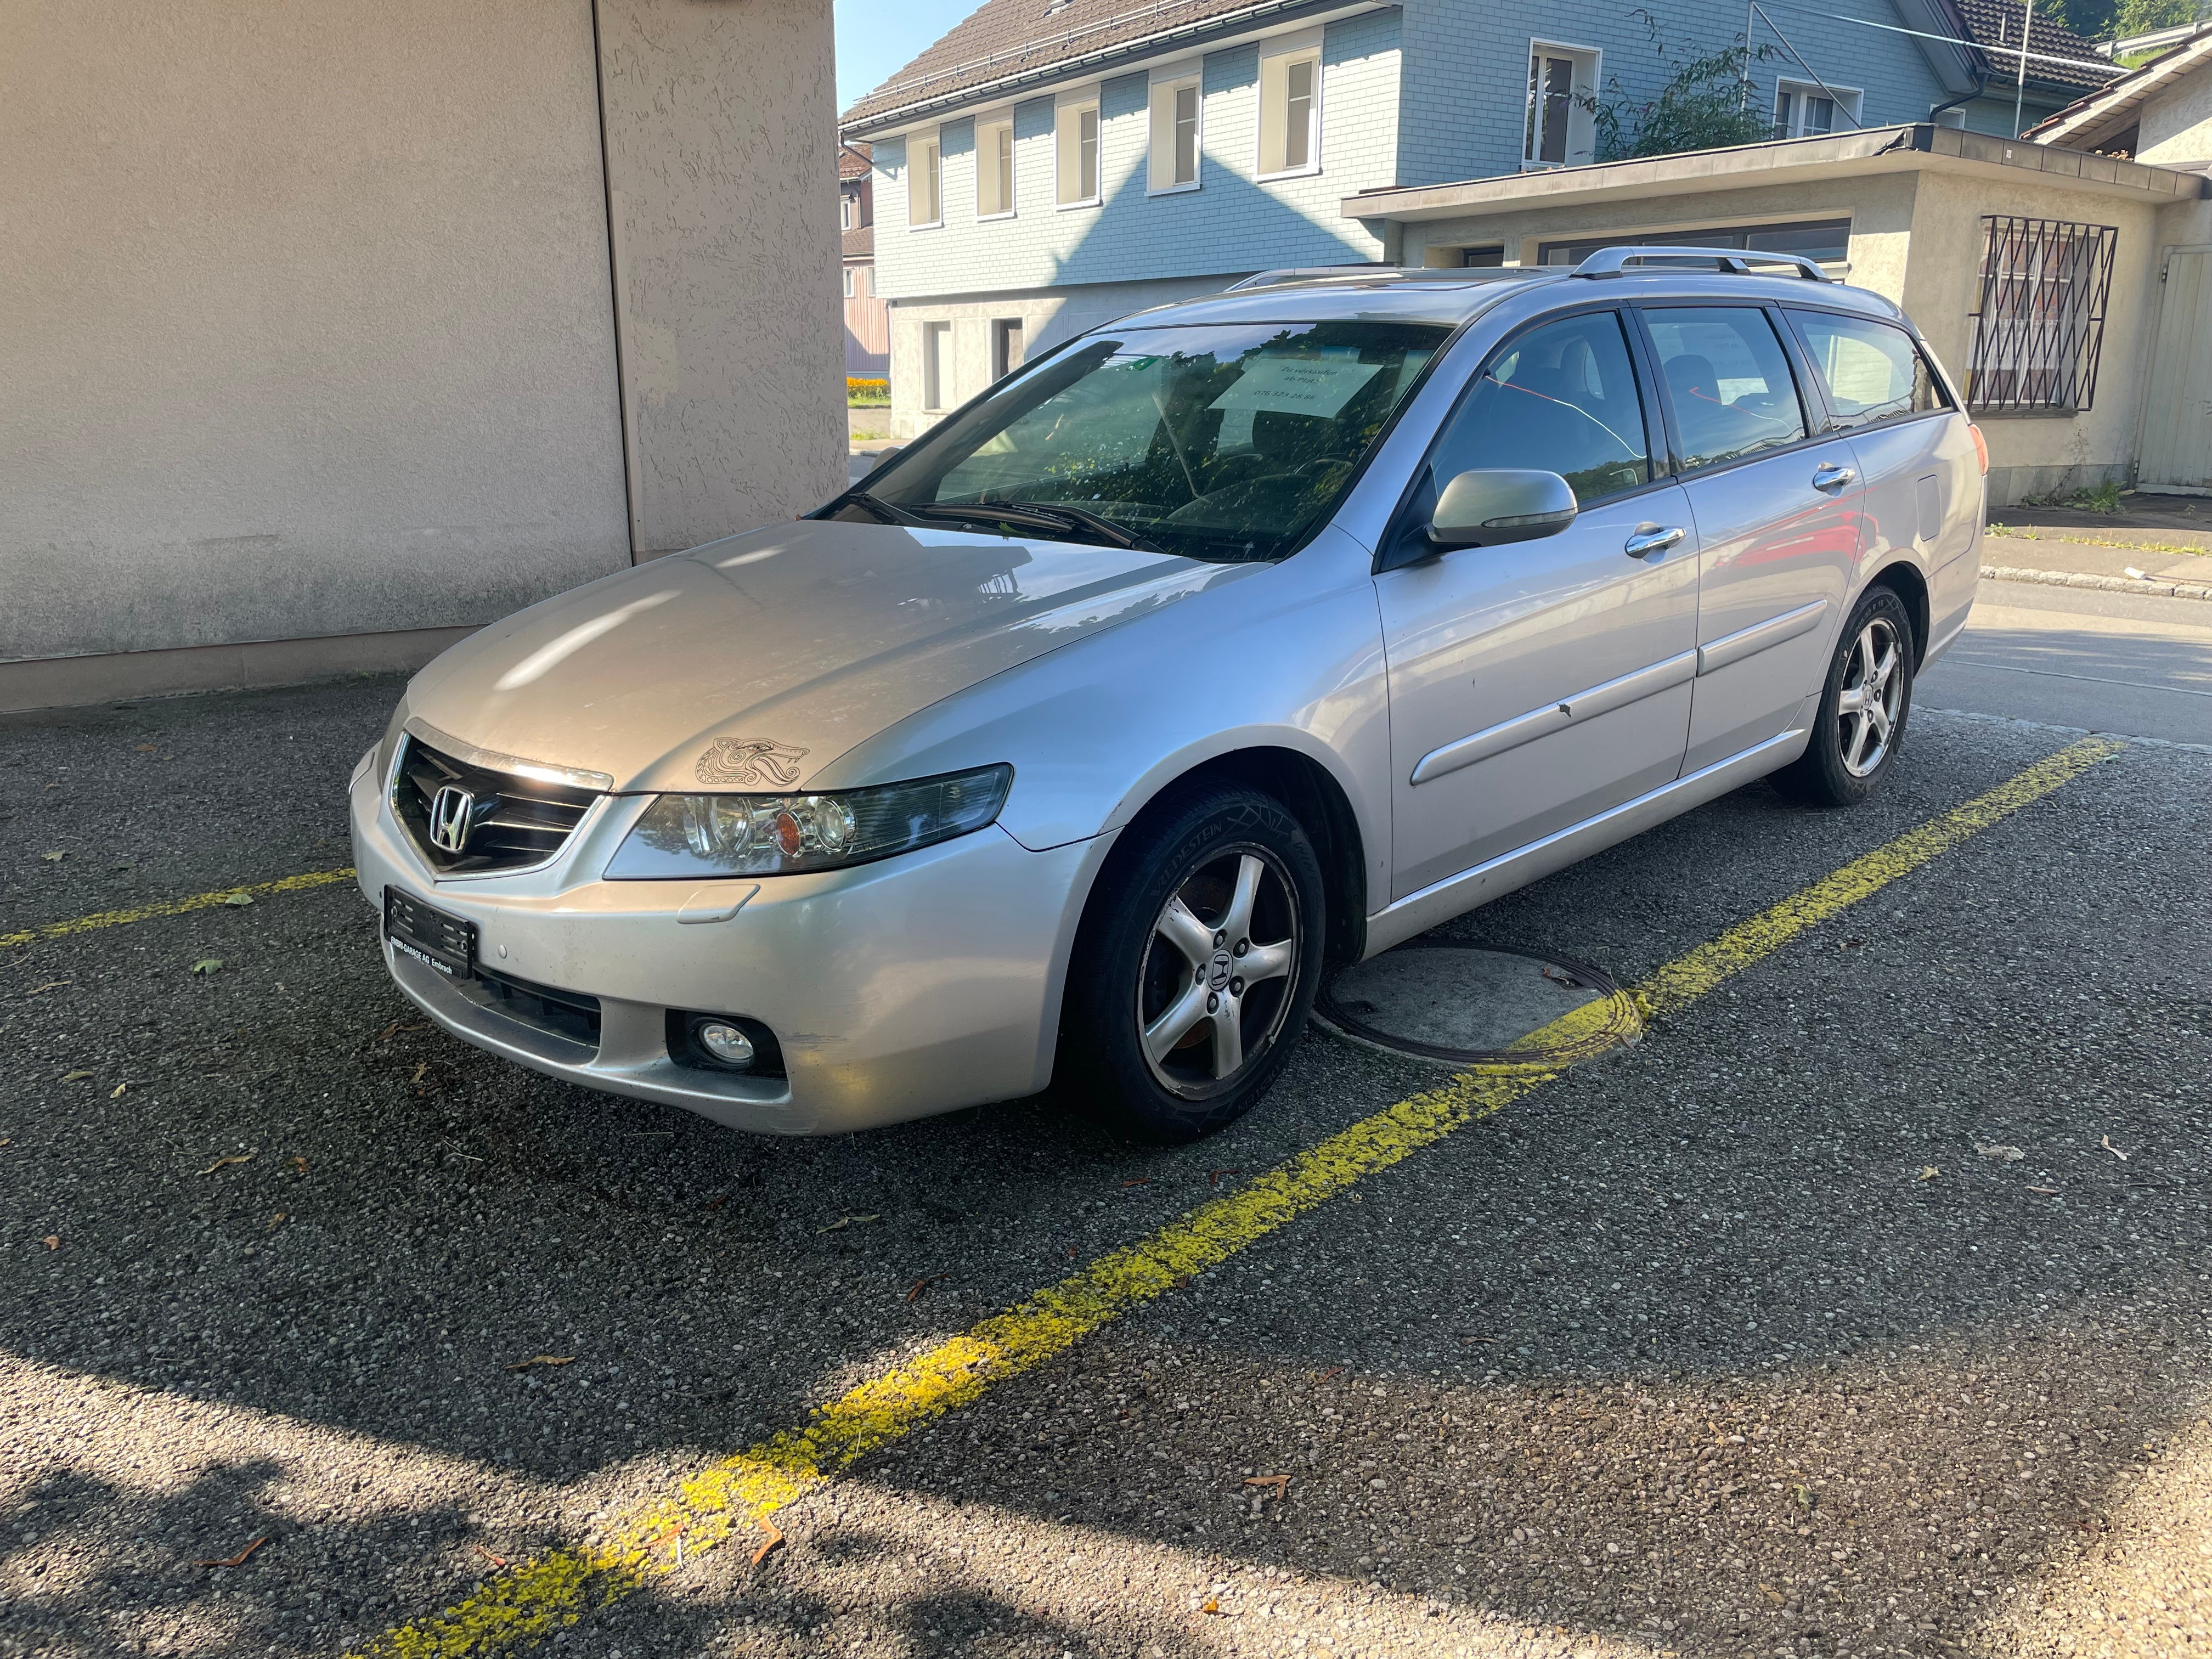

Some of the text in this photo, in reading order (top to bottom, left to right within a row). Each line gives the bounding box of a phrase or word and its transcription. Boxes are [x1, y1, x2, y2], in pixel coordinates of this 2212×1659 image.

[1150, 820, 1222, 896] VREDESTEIN
[391, 935, 422, 961] EMBRI-GARAGE
[422, 953, 430, 964] AG
[431, 958, 453, 975] Embrach
